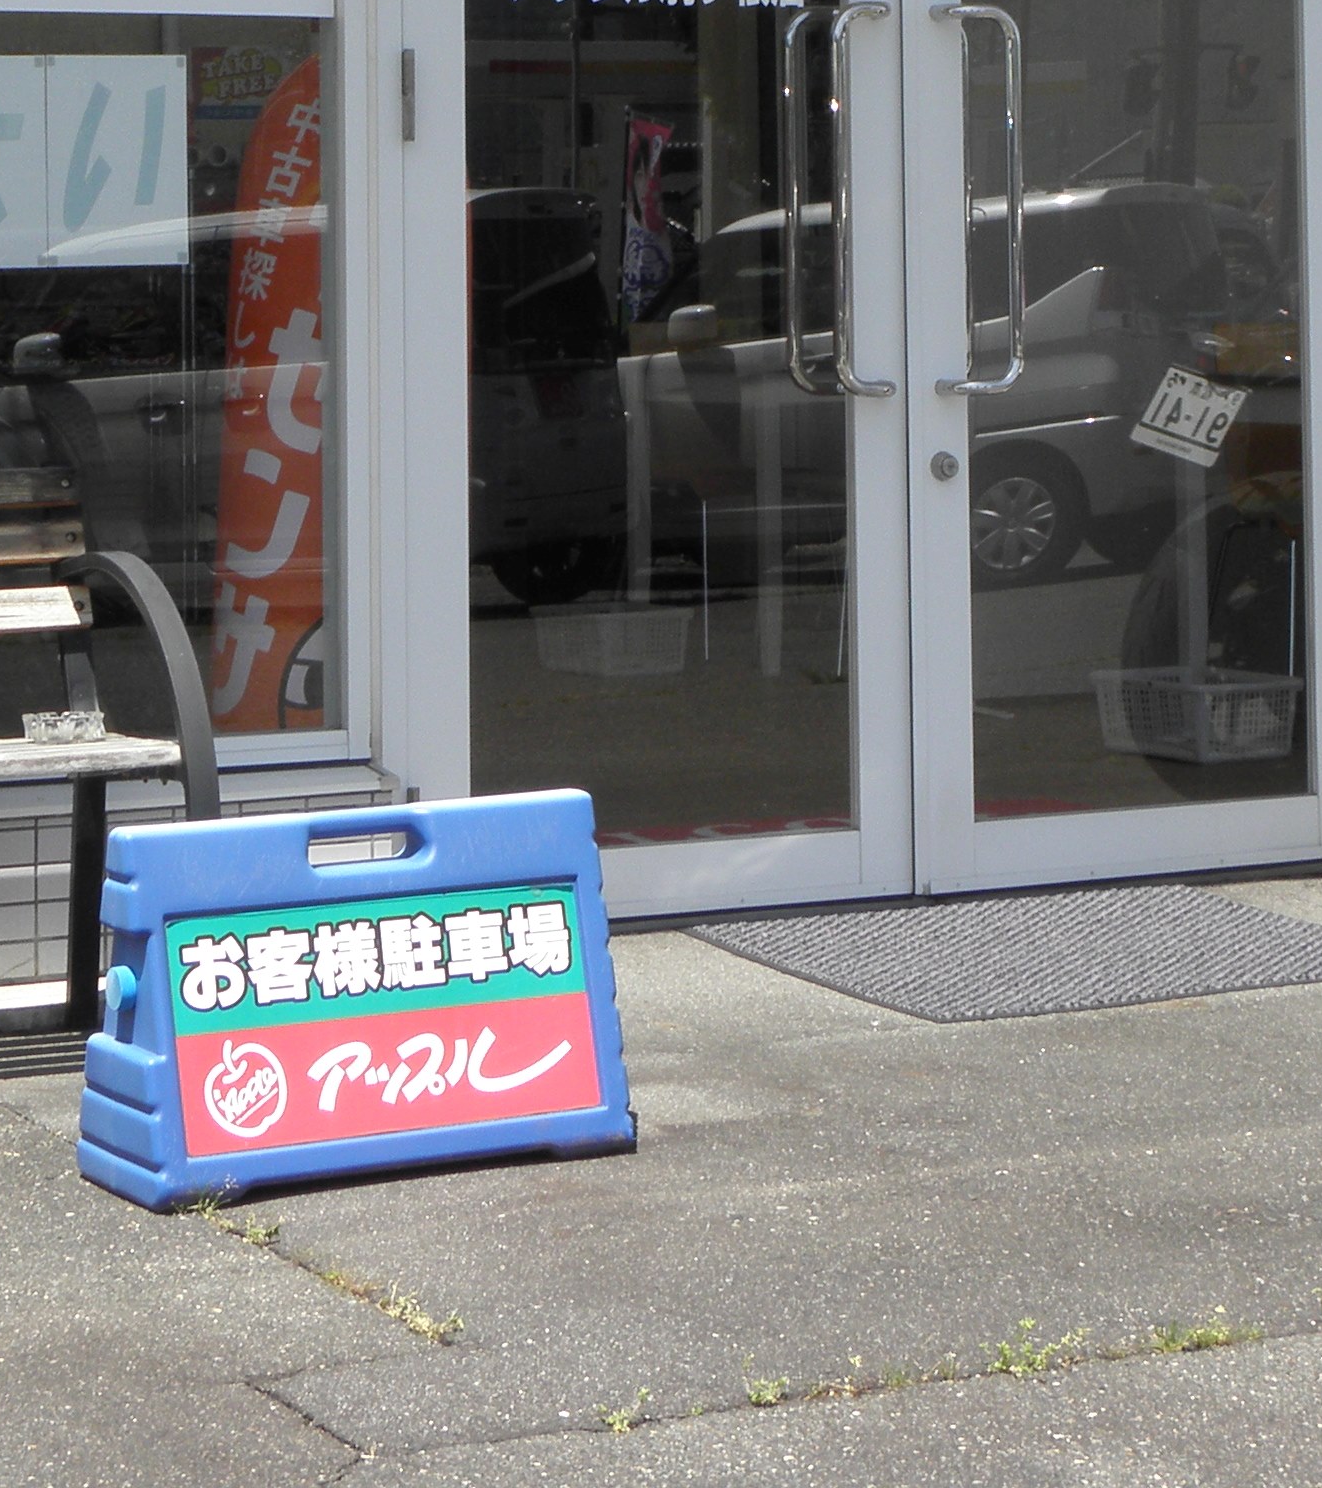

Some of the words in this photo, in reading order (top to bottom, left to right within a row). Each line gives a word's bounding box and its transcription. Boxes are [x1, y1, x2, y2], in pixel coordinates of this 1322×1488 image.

[200, 54, 265, 80] TAKE
[217, 73, 279, 99] FREE
[180, 902, 571, 1011] お客様駐車場
[307, 1026, 572, 1112] アップル
